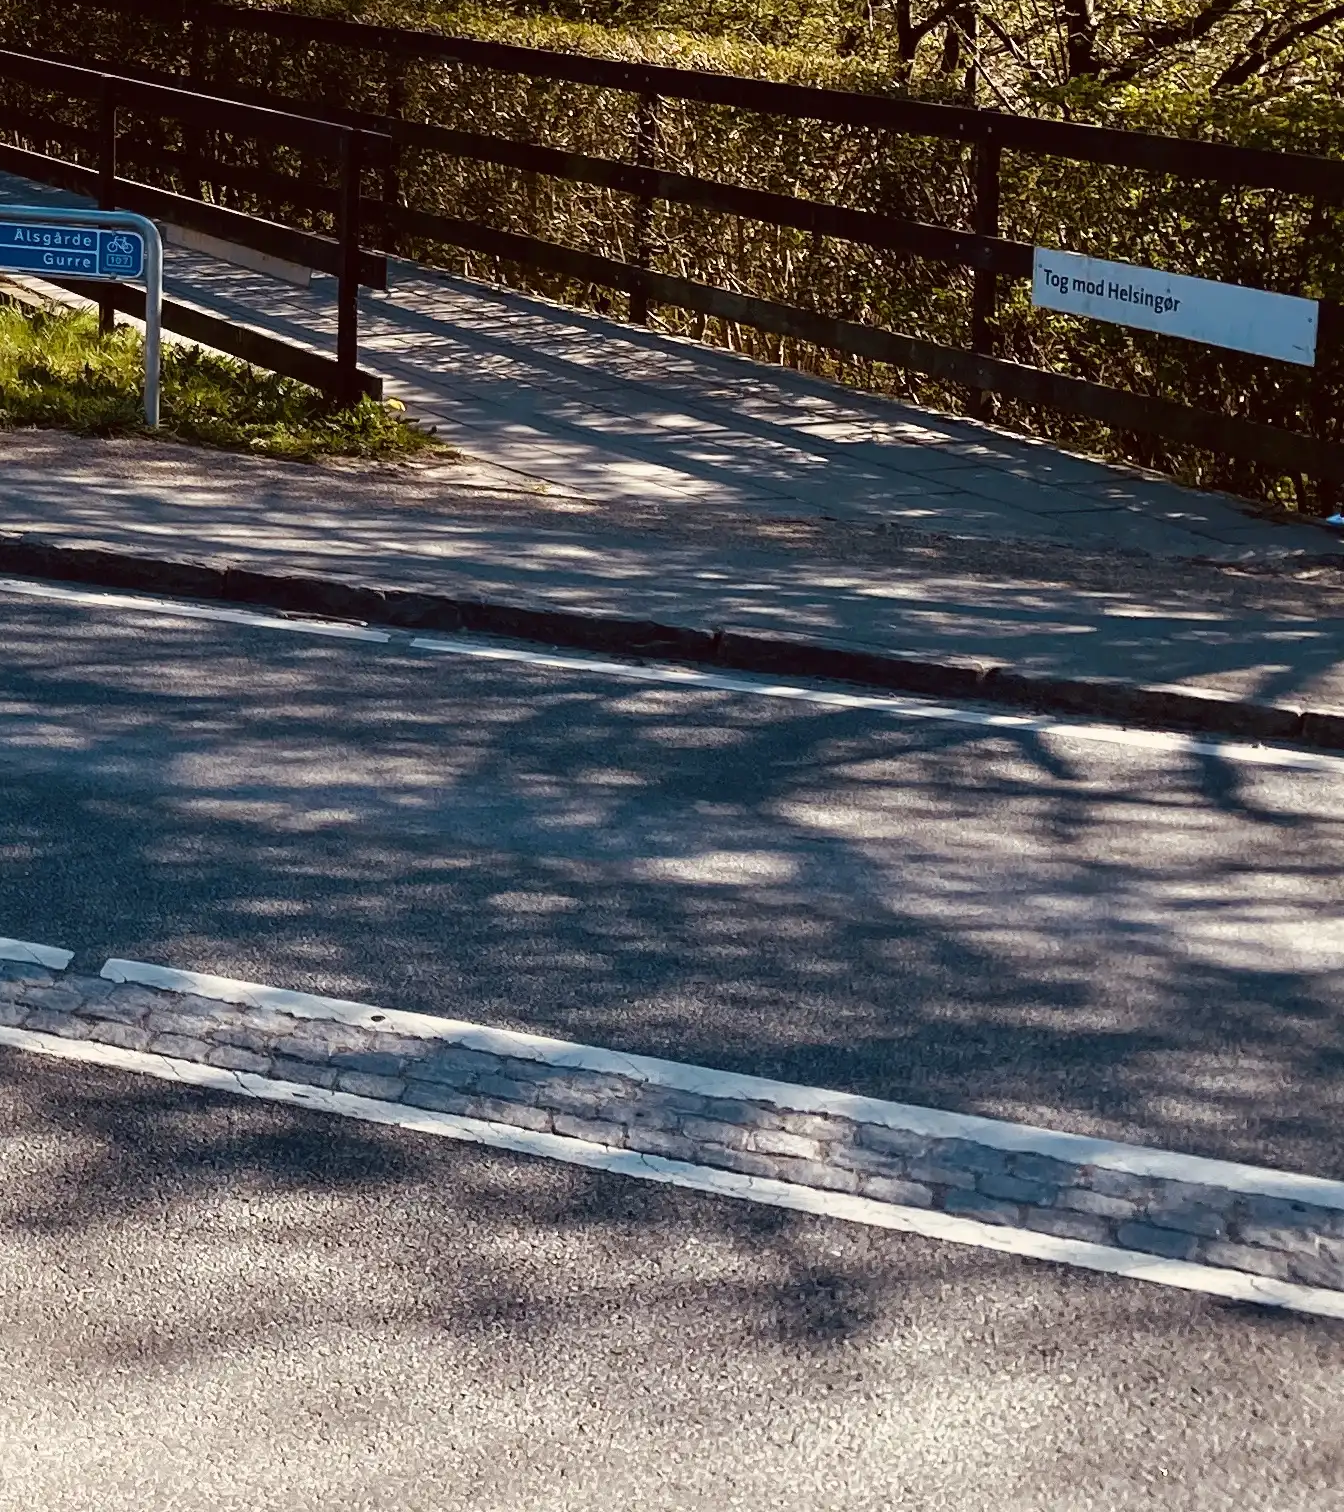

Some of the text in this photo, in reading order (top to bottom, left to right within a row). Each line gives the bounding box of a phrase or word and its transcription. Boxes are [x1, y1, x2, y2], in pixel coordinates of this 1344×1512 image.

[14, 228, 92, 247] Ålsgårde
[43, 252, 91, 268] Gurre
[111, 256, 129, 265] 107
[1043, 268, 1181, 314] Tog mod Helsingør
